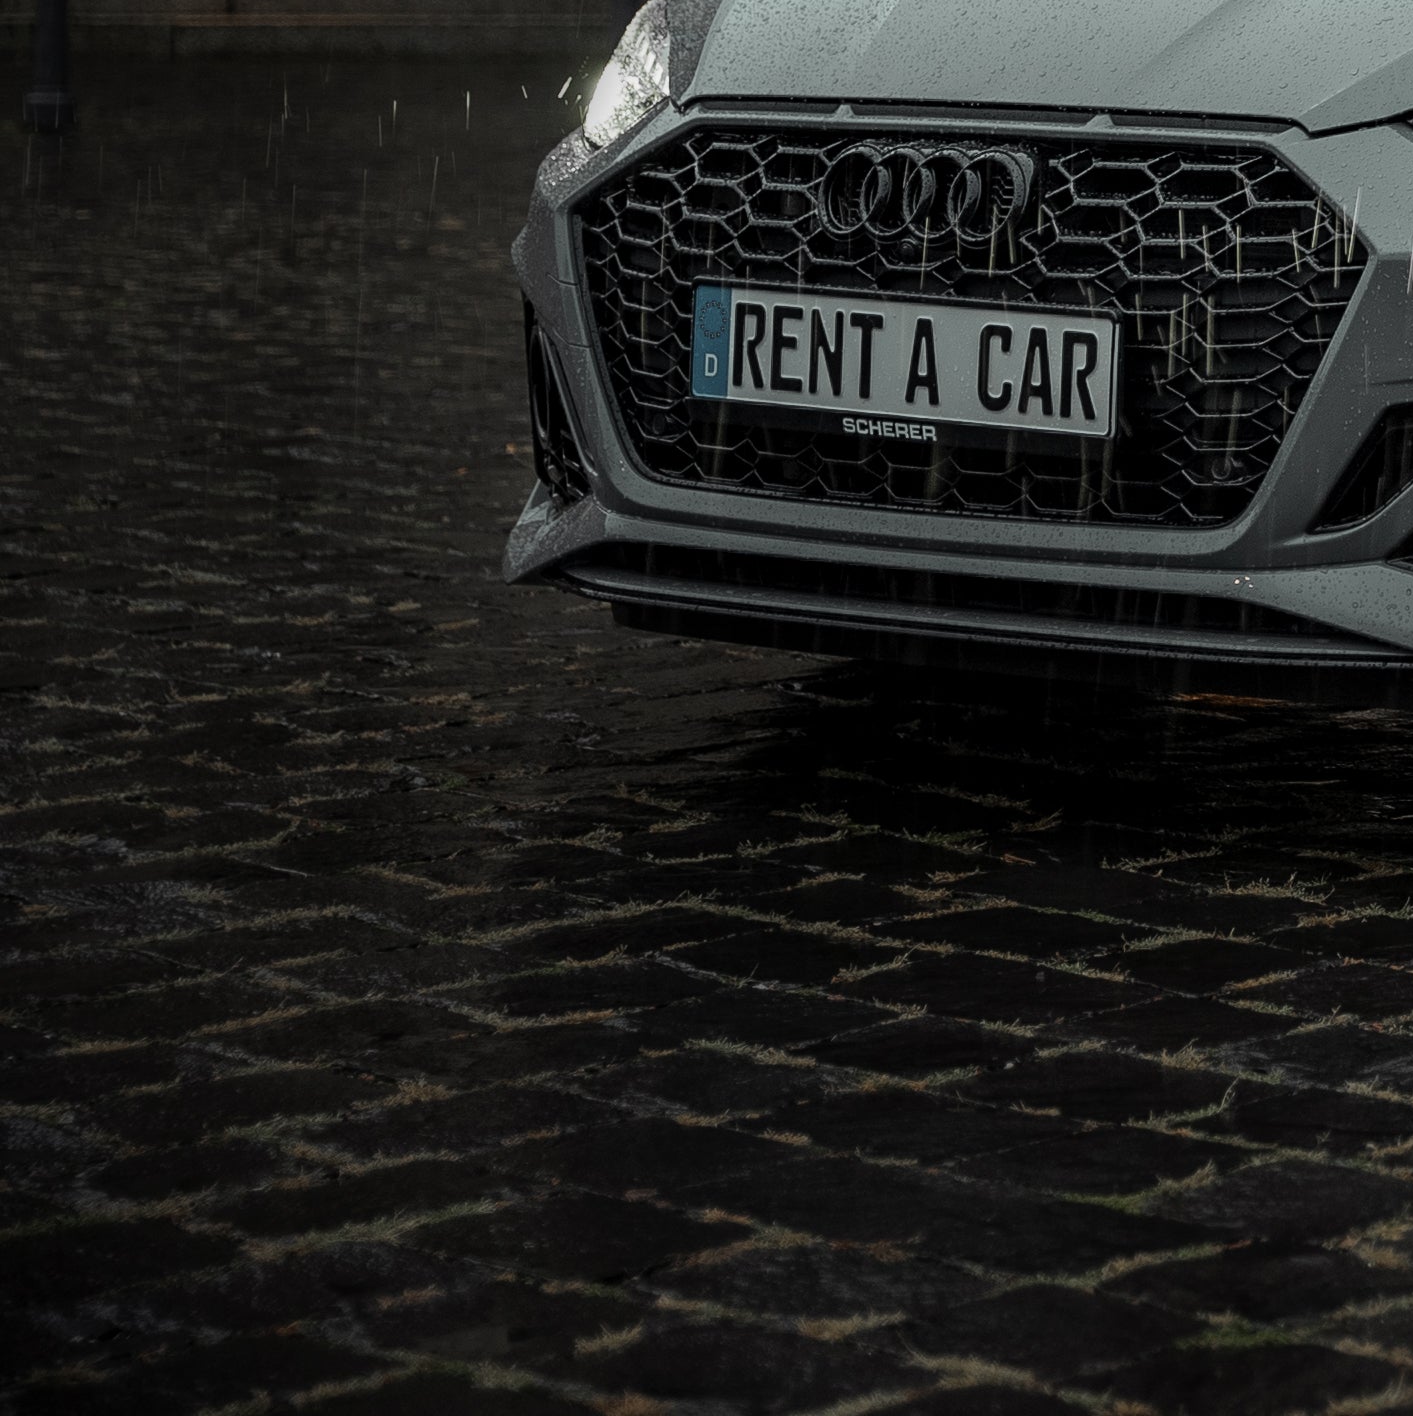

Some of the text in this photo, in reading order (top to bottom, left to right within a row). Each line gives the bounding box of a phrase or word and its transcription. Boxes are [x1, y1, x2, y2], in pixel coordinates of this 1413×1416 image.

[704, 353, 718, 378] D
[732, 300, 1099, 421] RENT A CAR
[842, 417, 938, 443] SCHERER
